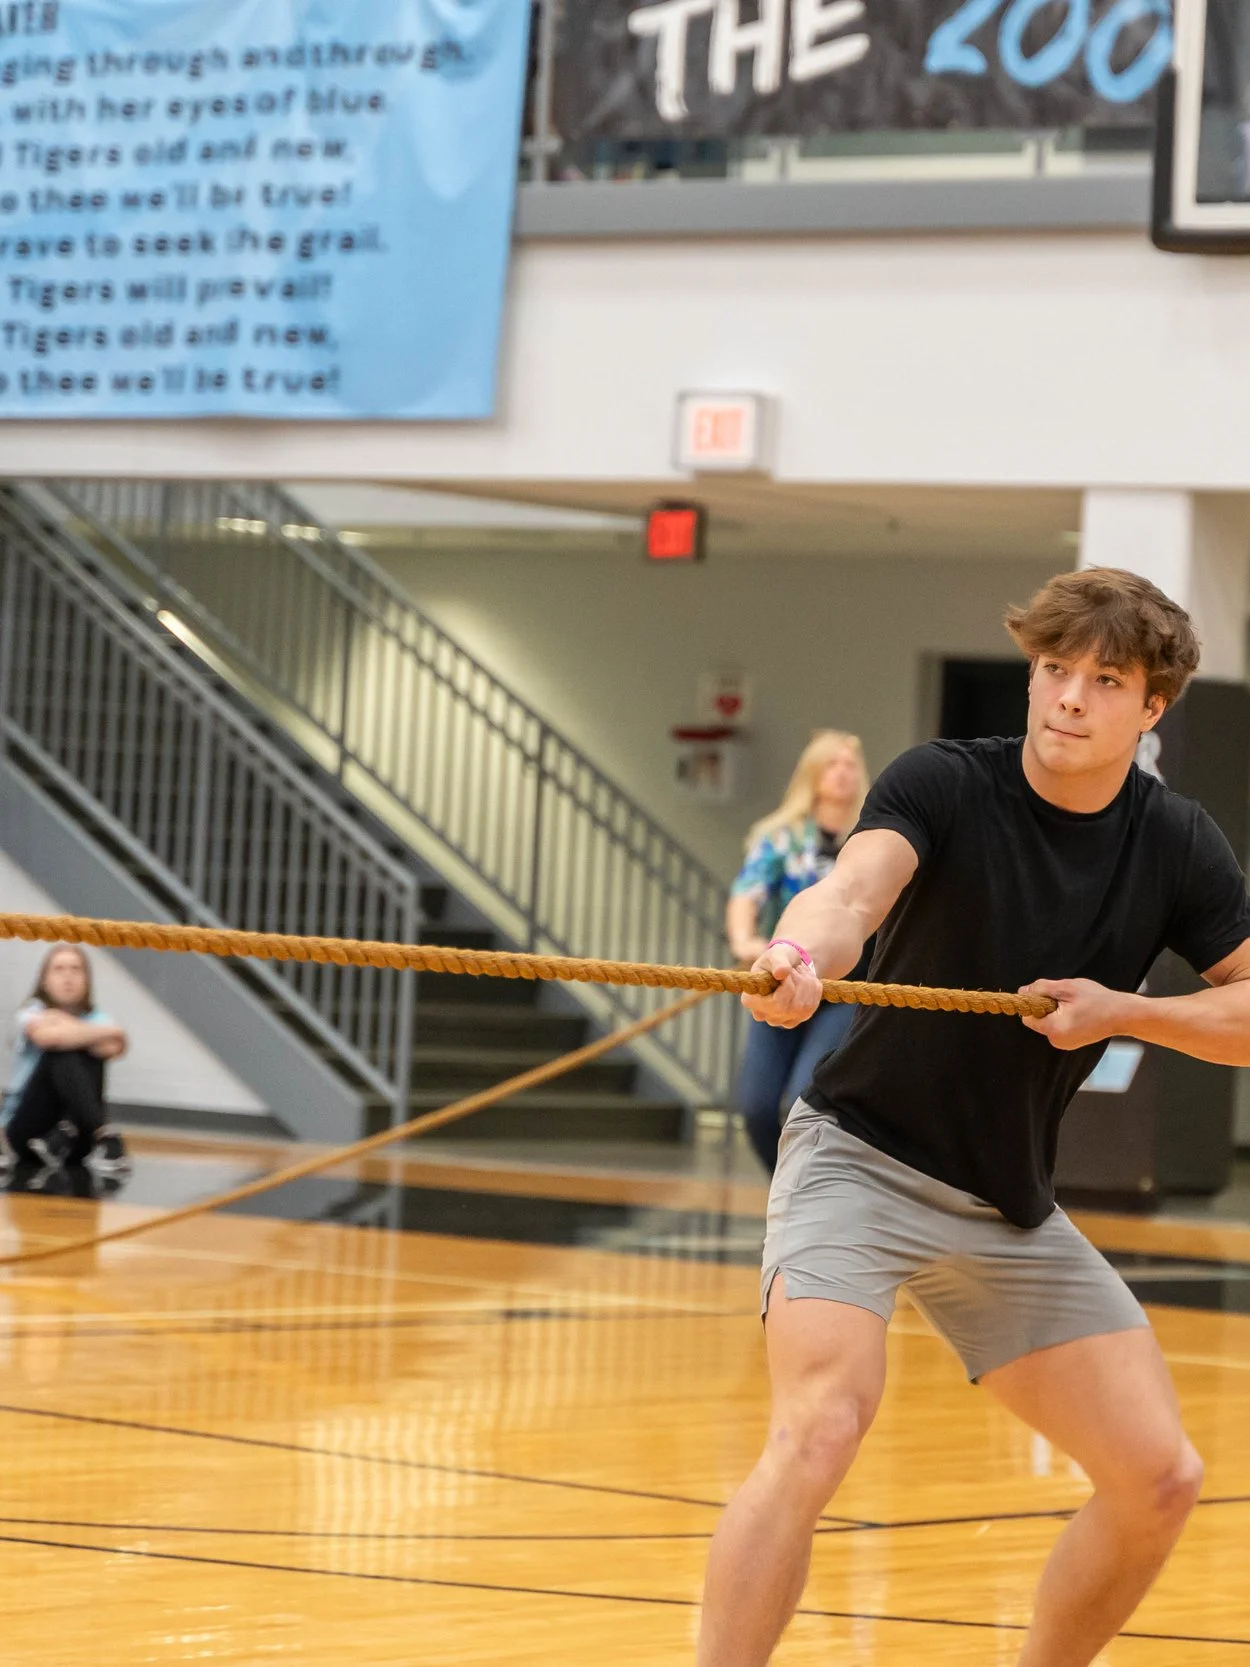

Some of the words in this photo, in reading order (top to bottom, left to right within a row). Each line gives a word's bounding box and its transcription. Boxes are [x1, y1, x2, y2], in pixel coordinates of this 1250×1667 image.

[86, 46, 229, 85] through
[241, 40, 305, 71] and
[627, 0, 872, 122] THE
[12, 95, 87, 124] with
[97, 92, 154, 124] her
[166, 96, 246, 129] eyes
[253, 86, 297, 116] of
[14, 139, 122, 175] Tigers
[132, 138, 189, 167] old
[199, 132, 258, 165] and
[28, 186, 109, 214] thee
[208, 181, 247, 210] be
[85, 230, 121, 260] to
[130, 230, 217, 260] seek
[225, 222, 287, 256] the
[8, 274, 113, 311] Tigers
[125, 272, 187, 301] will
[3, 319, 109, 356] Tigers
[119, 317, 173, 346] old
[184, 315, 239, 346] and
[19, 367, 98, 396] thee
[194, 366, 229, 394] be
[243, 363, 342, 396] true!
